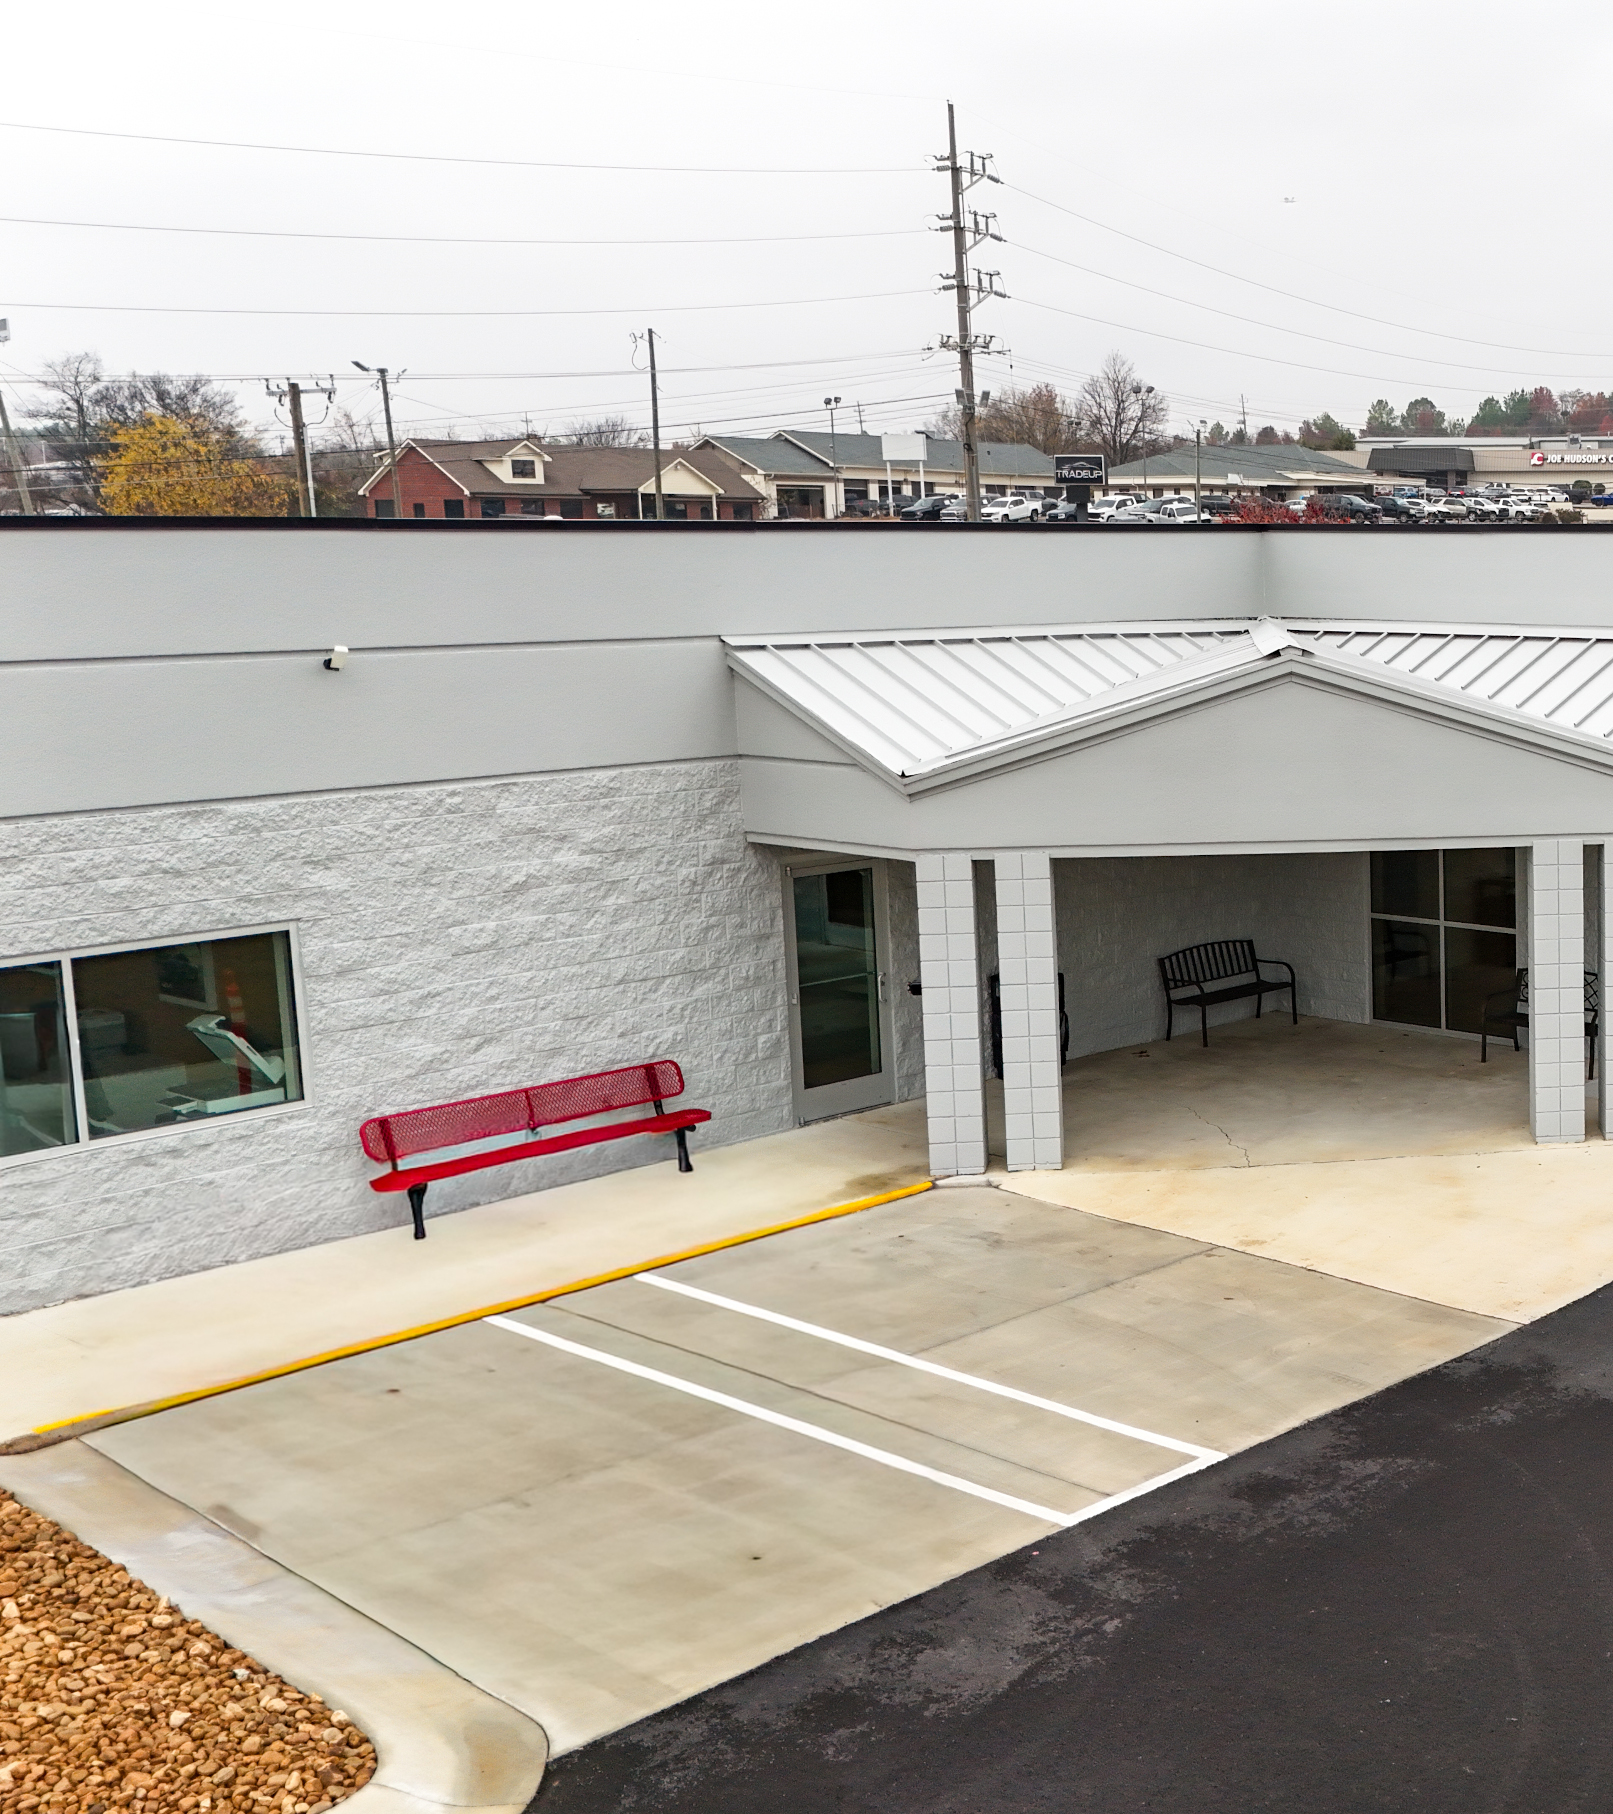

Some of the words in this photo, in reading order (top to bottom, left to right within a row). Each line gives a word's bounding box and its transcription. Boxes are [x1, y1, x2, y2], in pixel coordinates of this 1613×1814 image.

[1546, 454, 1562, 463] JOE
[1563, 454, 1606, 463] HUDSON'S
[1055, 470, 1102, 479] TRADEUP
